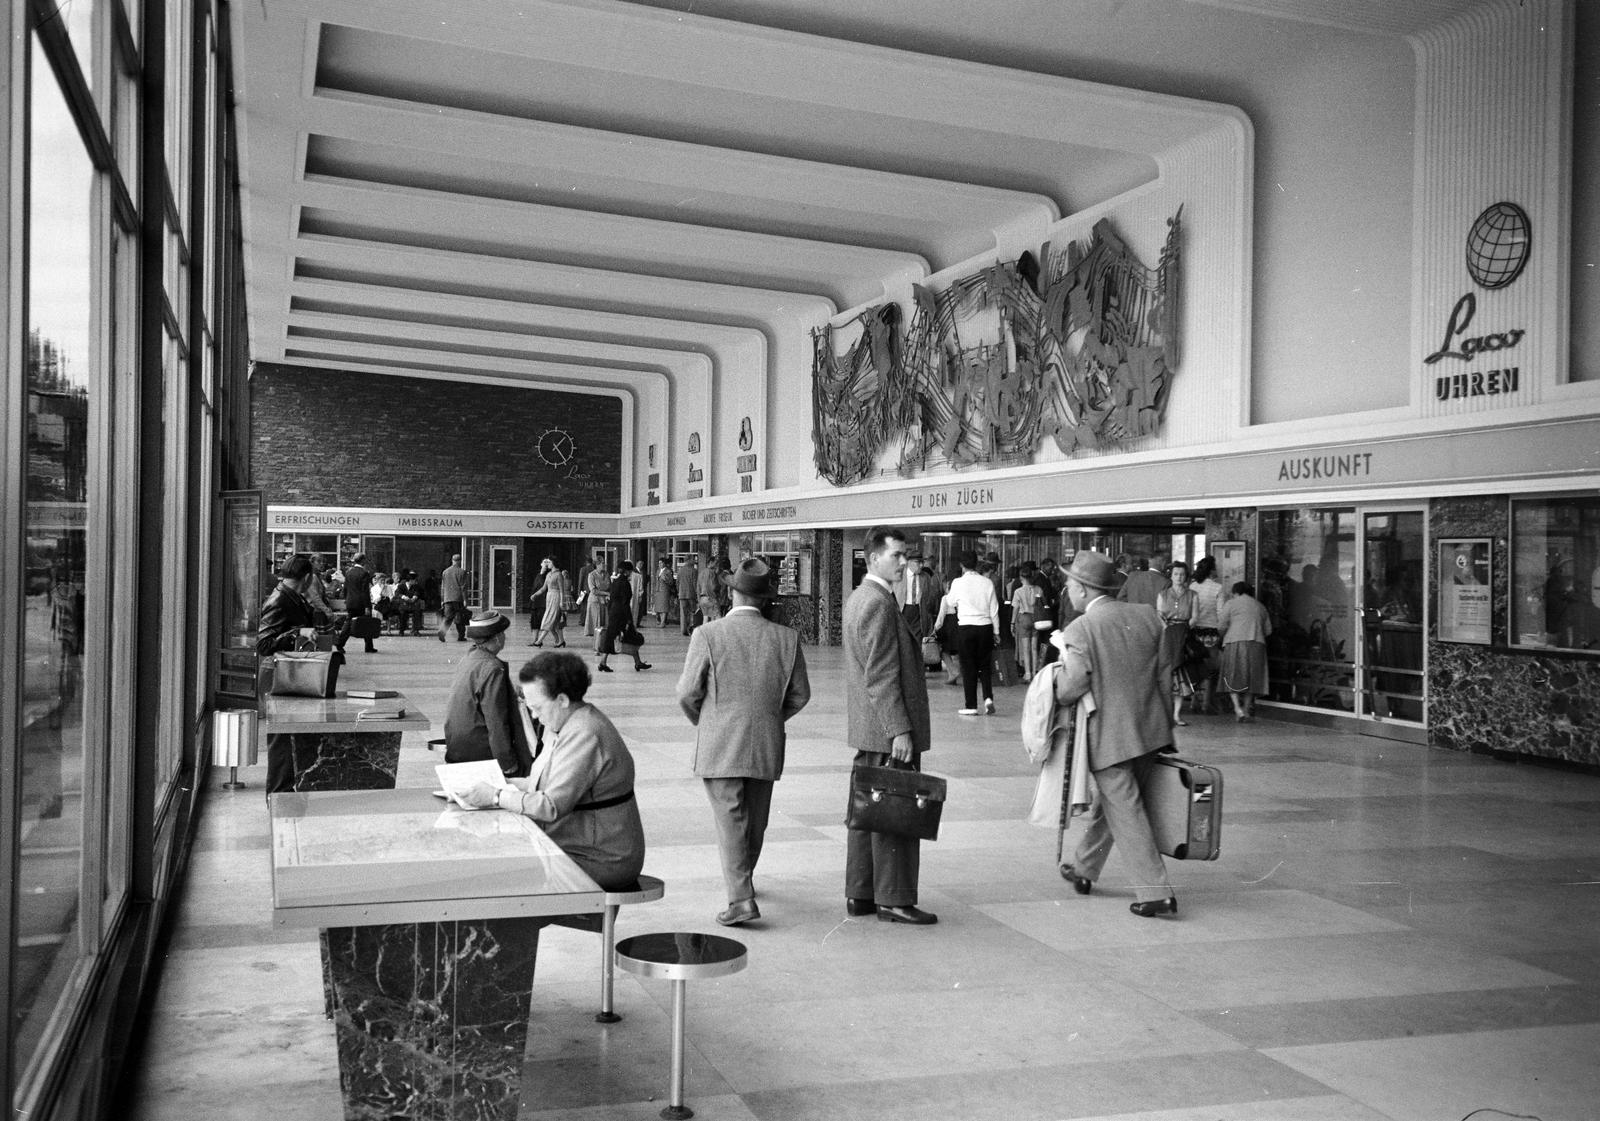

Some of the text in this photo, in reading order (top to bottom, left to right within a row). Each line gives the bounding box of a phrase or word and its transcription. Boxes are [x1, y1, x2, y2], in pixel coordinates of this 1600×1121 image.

[1424, 292, 1525, 364] Laco
[1436, 367, 1519, 401] UHREN
[1279, 453, 1372, 480] AUSKUNFT
[912, 487, 993, 508] ZU DEN ZÜGEN
[275, 515, 360, 525] ERFRISCHUNGEN
[399, 518, 463, 527] IMBISSRAUM
